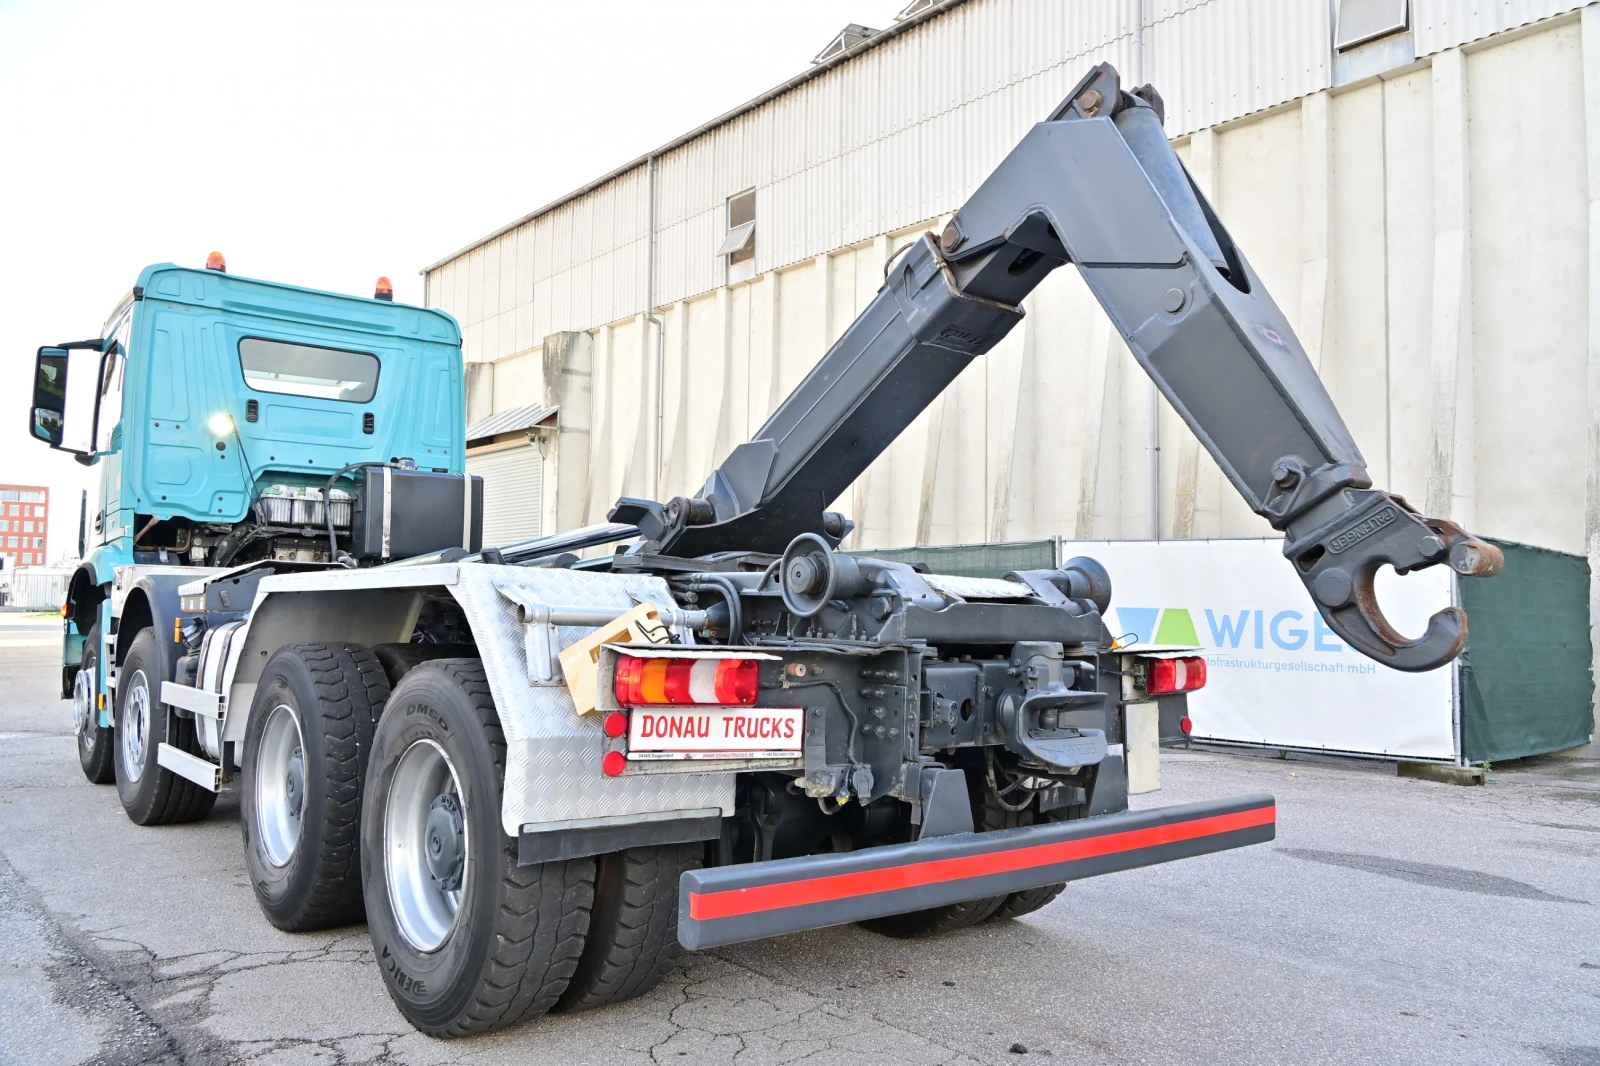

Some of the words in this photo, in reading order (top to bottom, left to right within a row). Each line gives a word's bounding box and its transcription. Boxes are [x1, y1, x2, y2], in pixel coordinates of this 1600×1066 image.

[1331, 508, 1394, 550] PALFINGER
[1204, 608, 1359, 653] WIGE
[1206, 656, 1343, 673] Infrastrukturgesellschaft
[1347, 663, 1376, 674] mbH
[406, 703, 449, 731] DMSD
[641, 715, 710, 738] DONAU
[722, 716, 795, 739] TRUCKS
